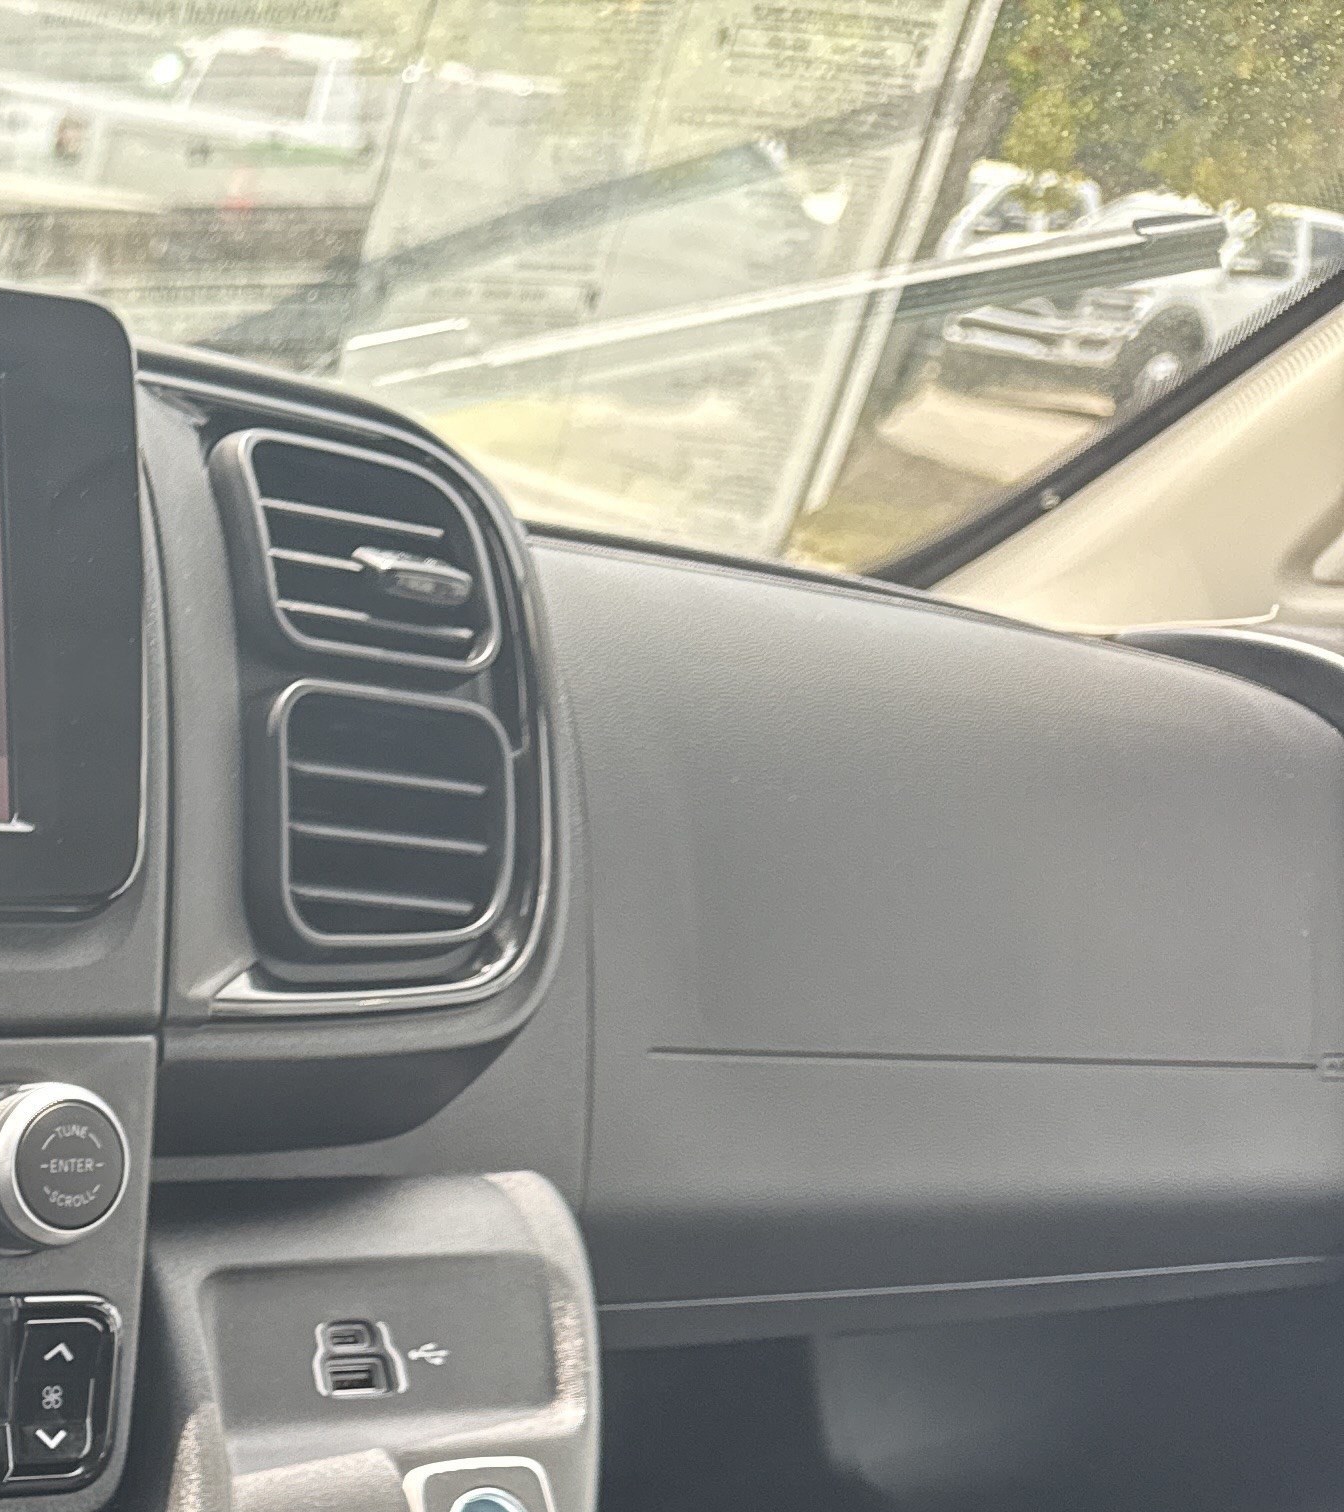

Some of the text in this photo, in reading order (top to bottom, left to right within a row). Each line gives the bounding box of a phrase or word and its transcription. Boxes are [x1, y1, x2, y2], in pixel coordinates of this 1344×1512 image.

[55, 1124, 88, 1139] TUNE
[50, 1158, 94, 1173] ENTER
[49, 1190, 95, 1207] SCROLL
